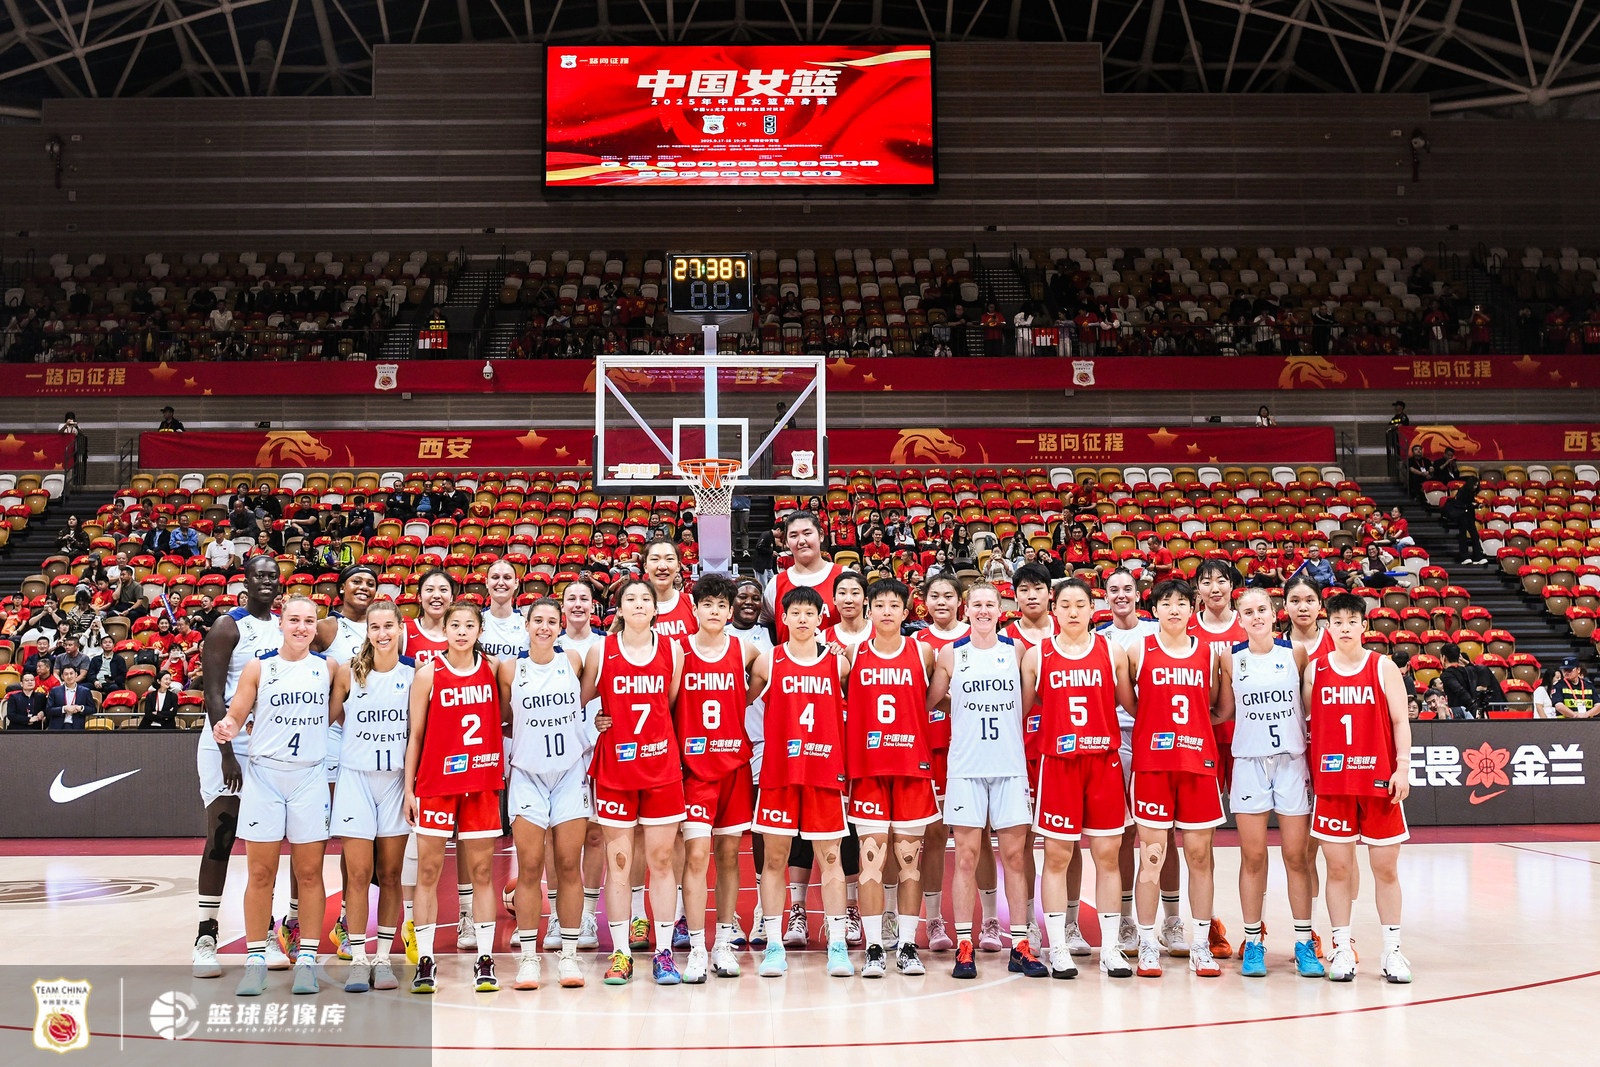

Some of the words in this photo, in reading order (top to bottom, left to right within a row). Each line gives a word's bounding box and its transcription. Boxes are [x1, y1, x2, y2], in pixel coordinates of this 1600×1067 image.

[637, 69, 842, 97] 中国女篮
[651, 97, 828, 106] 2025年中国女篮热身赛
[25, 367, 126, 385] 一路向征程
[1393, 360, 1492, 378] 一路向征程
[417, 437, 473, 459] 西安
[1016, 432, 1124, 452] 一路向征程
[651, 619, 688, 636] HINA
[483, 643, 524, 656] RIFOLS
[613, 675, 665, 695] CHINA
[684, 672, 735, 691] CHINA
[781, 675, 833, 696] CHINA
[859, 667, 913, 686] CHINA
[962, 678, 1014, 694] GRIFOLS
[1049, 668, 1103, 689] CHINA
[1151, 667, 1204, 688] CHINA
[270, 691, 325, 707] GRIFOLS
[440, 684, 493, 707] CHINA
[522, 692, 576, 710] GRIFOLS
[1242, 690, 1294, 706] GRIFOLS
[1320, 686, 1376, 705] CHINA
[631, 703, 651, 735] 7
[702, 699, 721, 730] 8
[799, 702, 815, 733] 4
[877, 694, 896, 724] 6
[1068, 696, 1088, 727] 5
[1171, 694, 1190, 725] 3
[270, 715, 324, 726] OVENTUT
[461, 713, 483, 746] 2
[980, 717, 999, 741] 15
[1339, 714, 1353, 746] 1
[287, 732, 301, 757] 4
[355, 729, 410, 743] JOVENTU
[544, 732, 565, 758] 10
[1268, 724, 1281, 748] 5
[375, 749, 392, 772] 11
[1510, 743, 1586, 785] 金兰
[423, 809, 455, 825] TCL
[597, 799, 628, 816] TCL
[761, 808, 792, 824] TCL
[853, 800, 884, 816] TCL
[1137, 800, 1168, 817] TCL
[1043, 812, 1074, 829] TCL
[1317, 815, 1352, 832] TCL
